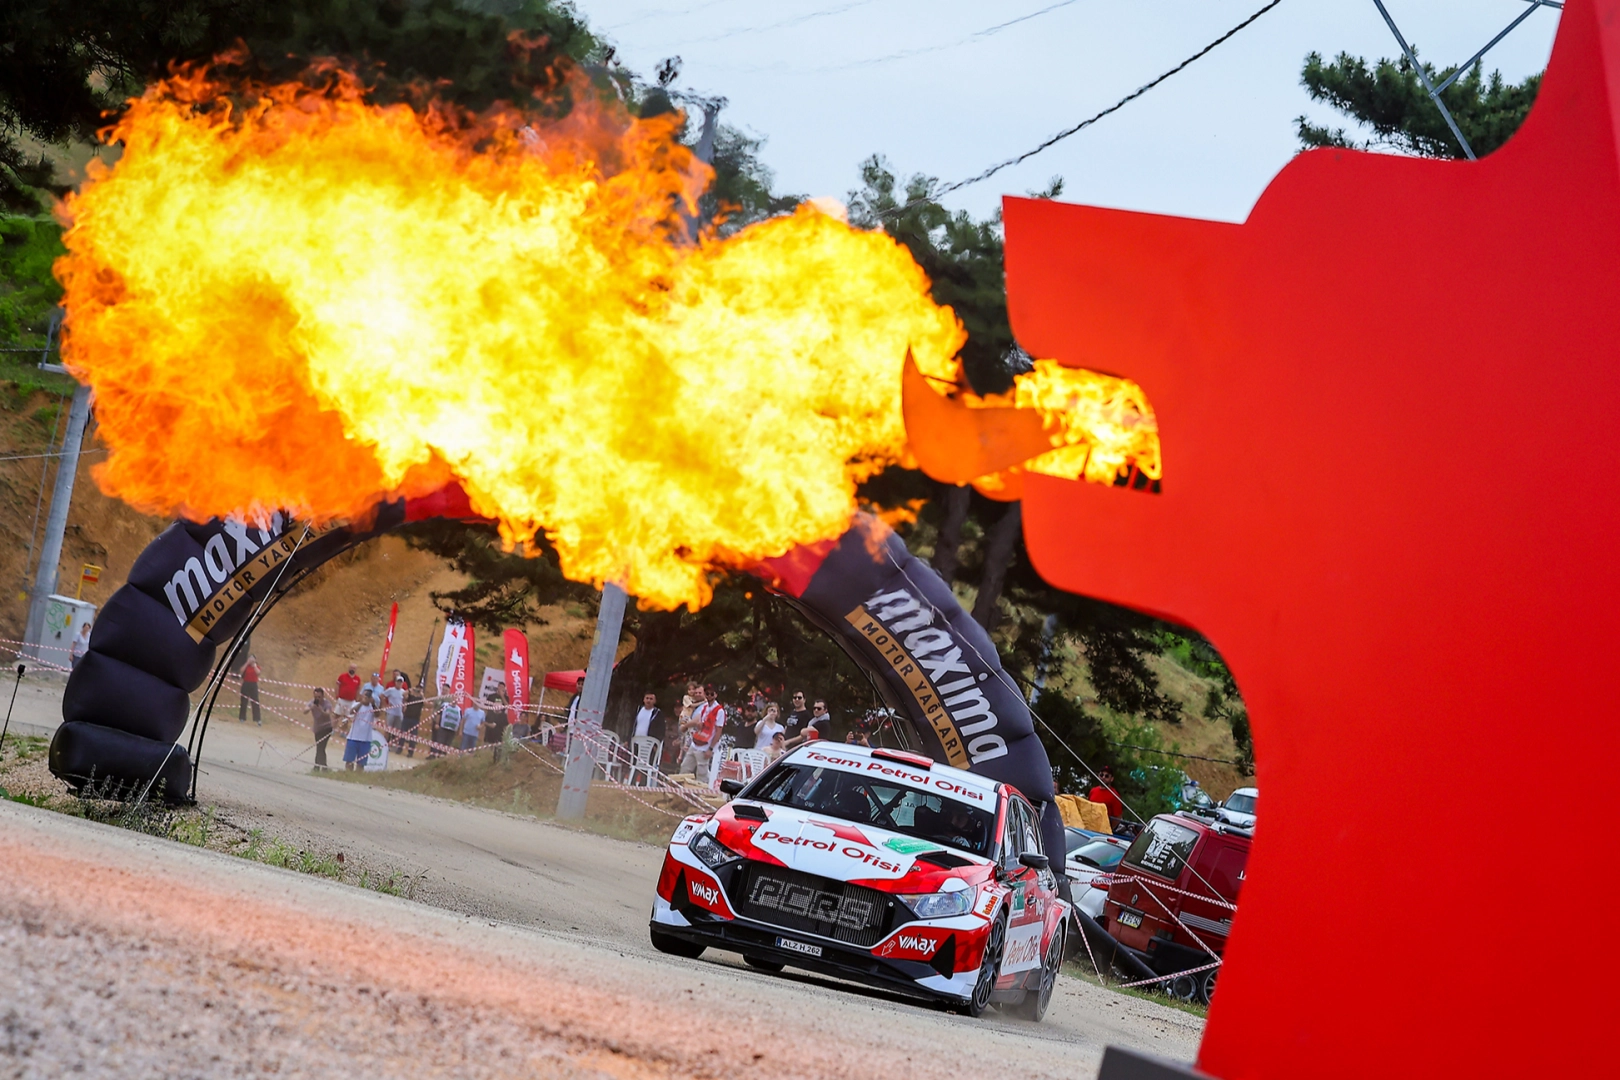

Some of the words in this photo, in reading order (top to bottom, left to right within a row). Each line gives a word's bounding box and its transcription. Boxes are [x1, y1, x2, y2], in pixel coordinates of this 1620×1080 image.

[200, 570, 256, 627] MOTOR
[862, 621, 915, 677] MOTOR
[913, 680, 962, 759] YAĞLARI
[864, 588, 1008, 765] maxima
[806, 751, 862, 769] Team
[866, 762, 930, 785] Petrol
[935, 780, 983, 801] Ofisi
[760, 831, 837, 852] Petrol
[842, 847, 900, 873] Ofisi
[782, 940, 798, 950] ALZ
[799, 944, 806, 952] H
[806, 945, 821, 955] 262
